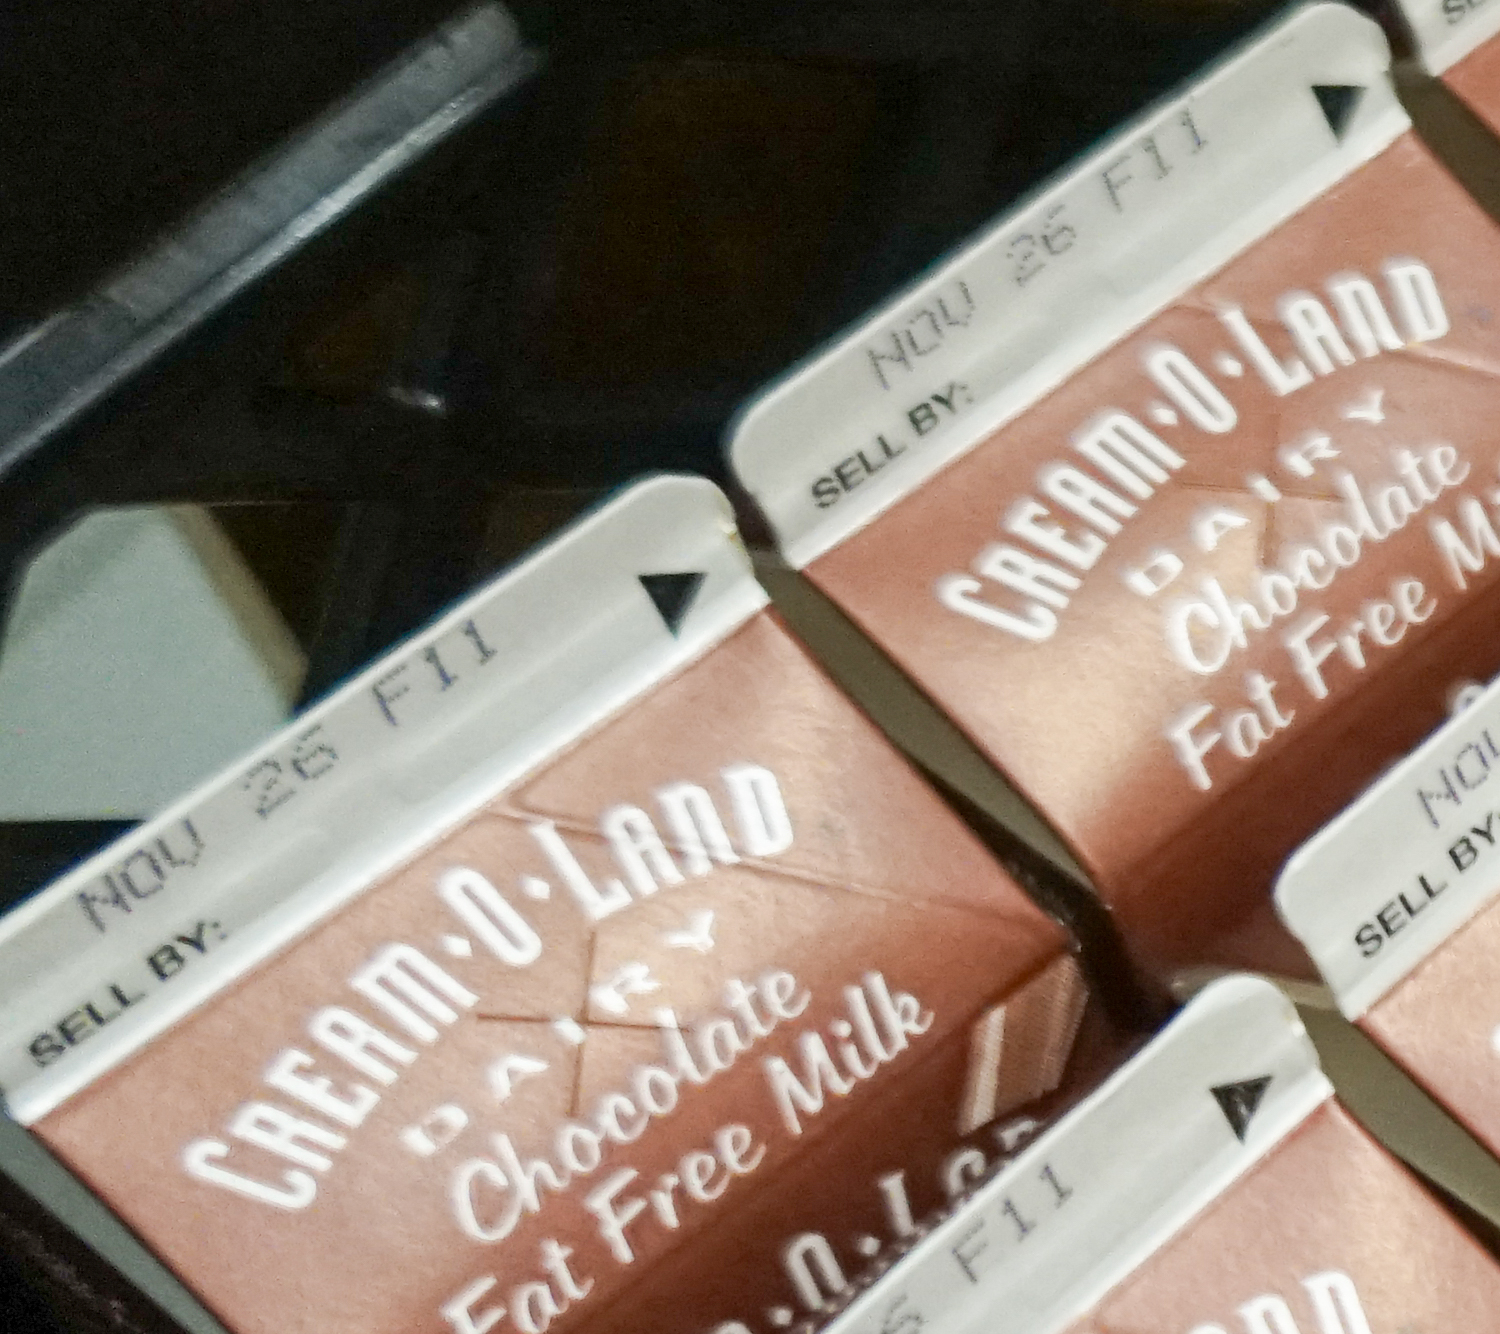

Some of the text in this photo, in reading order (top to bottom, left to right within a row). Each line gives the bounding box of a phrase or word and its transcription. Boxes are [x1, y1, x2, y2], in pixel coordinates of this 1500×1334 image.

[811, 380, 973, 509] SELL BY:
[1169, 440, 1471, 676] Chocolate
[244, 723, 339, 819] 26
[1168, 676, 1296, 790] Fat
[1291, 576, 1436, 700] Free
[28, 918, 227, 1068] SELL BY:
[1353, 874, 1449, 959] SELL
[450, 967, 809, 1244] Chocolate
[592, 1120, 764, 1264] Free
[757, 972, 934, 1134] Milk
